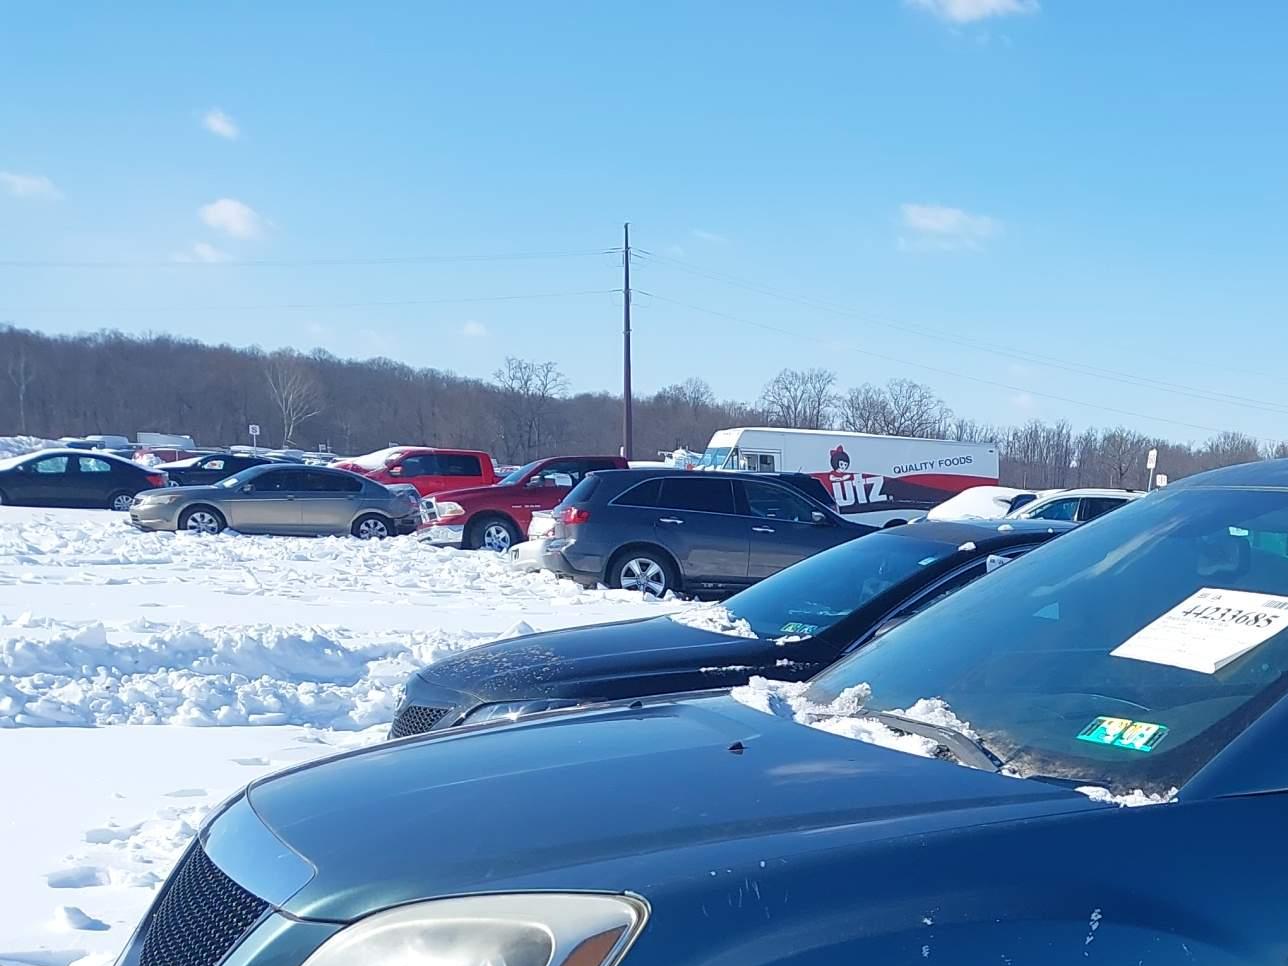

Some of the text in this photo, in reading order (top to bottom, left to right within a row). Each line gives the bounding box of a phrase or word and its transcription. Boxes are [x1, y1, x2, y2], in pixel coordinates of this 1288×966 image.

[893, 455, 973, 474] QUALITY FOODS
[1182, 604, 1281, 628] 44233685
